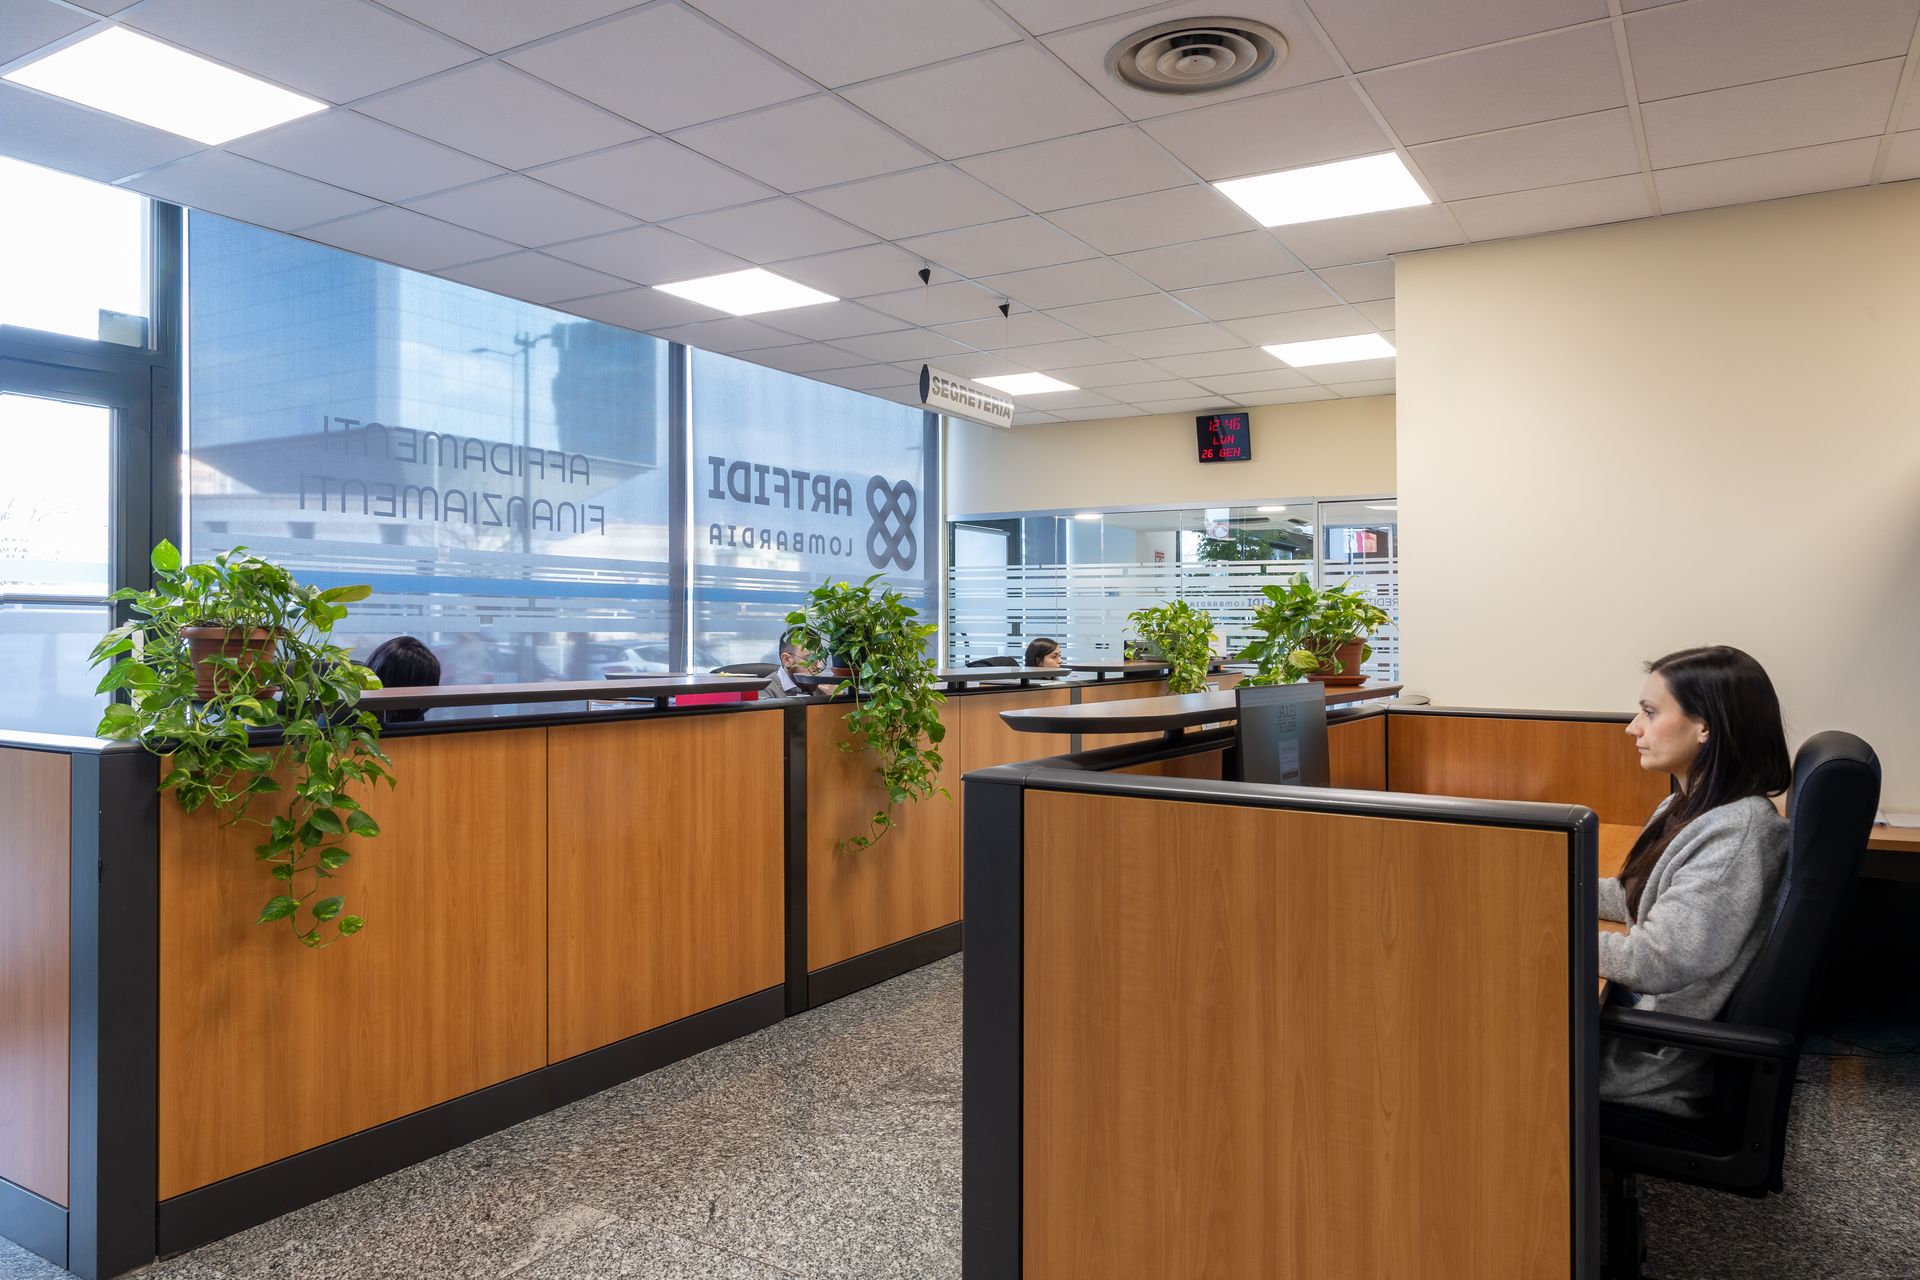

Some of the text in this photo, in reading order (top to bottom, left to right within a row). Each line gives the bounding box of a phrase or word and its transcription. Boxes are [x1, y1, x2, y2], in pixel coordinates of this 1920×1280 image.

[931, 376, 1010, 419] SEGRETERIA
[1212, 434, 1235, 445] LUN
[1201, 447, 1241, 459] 26 GEN
